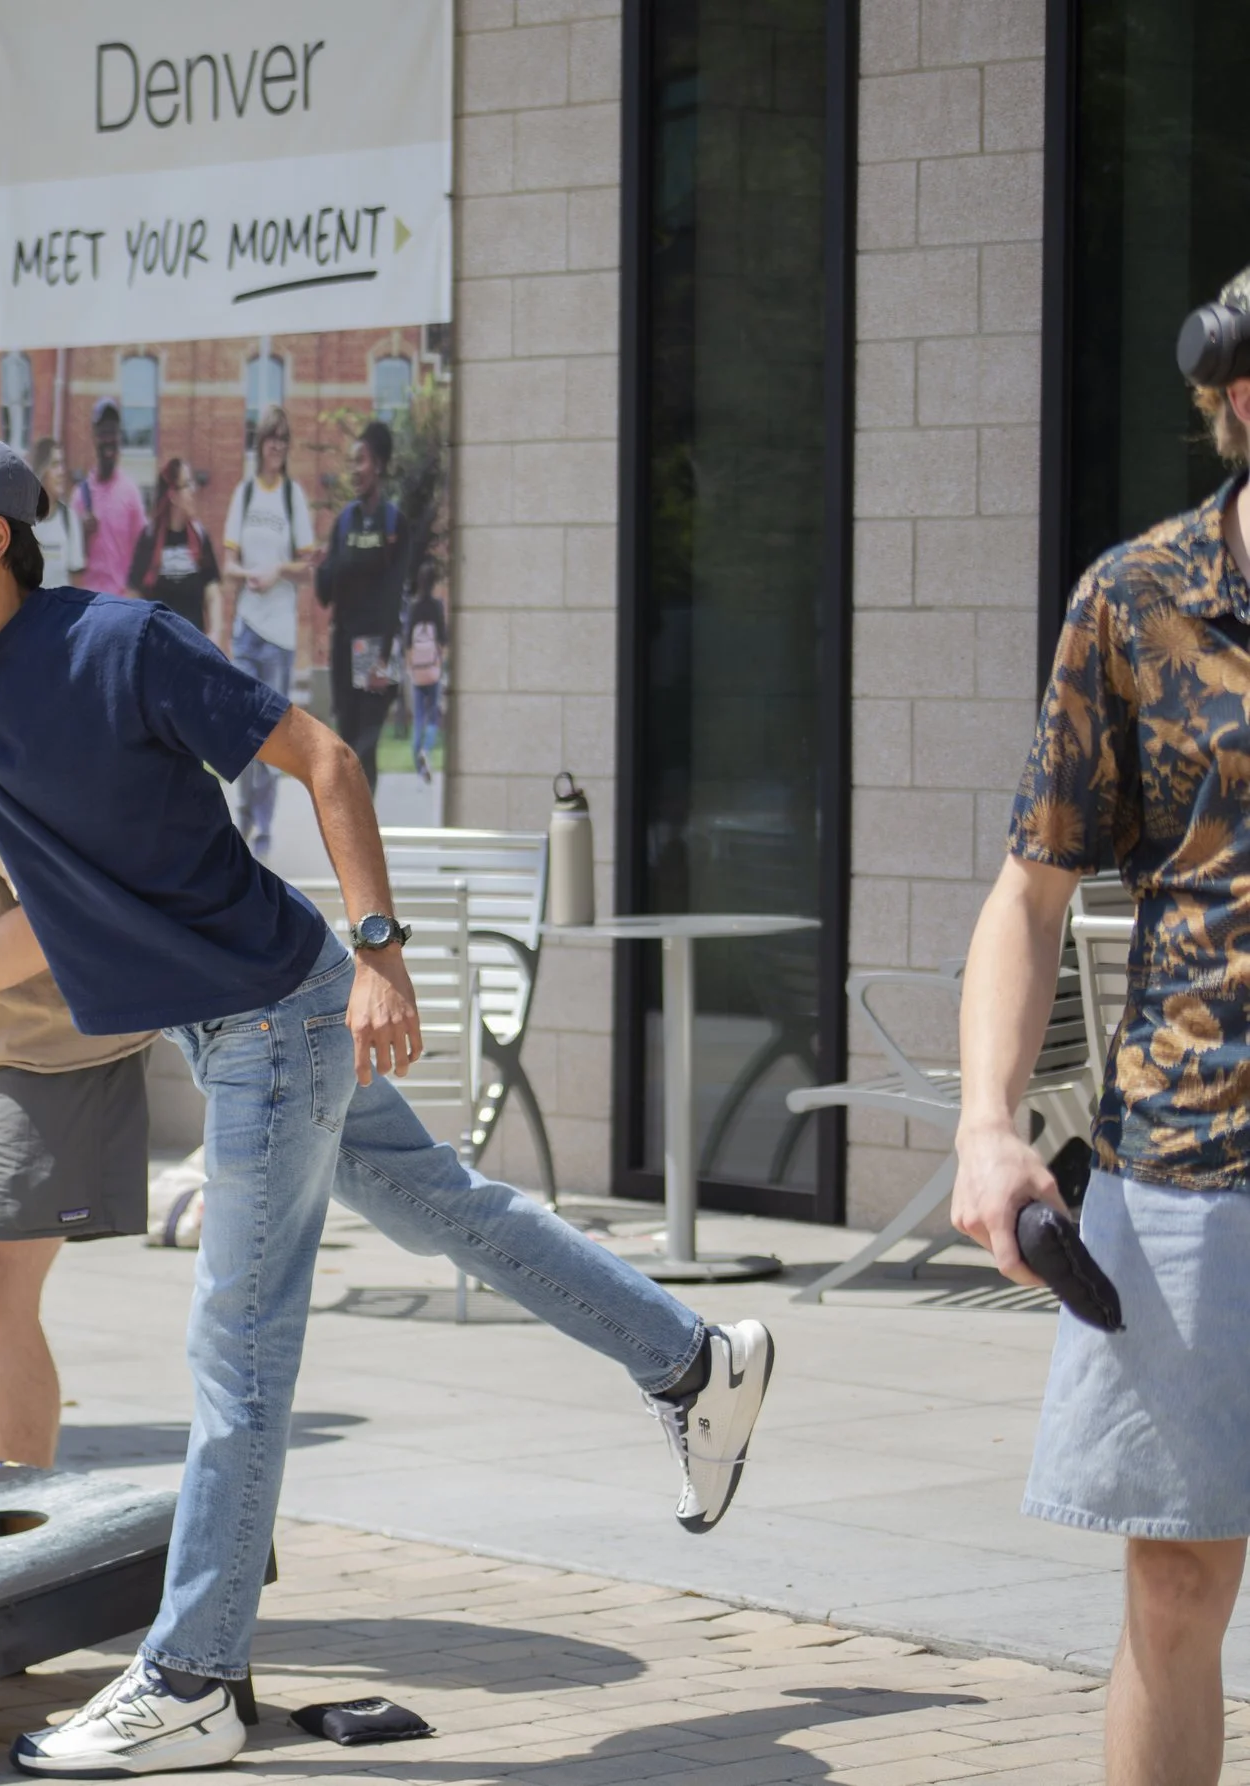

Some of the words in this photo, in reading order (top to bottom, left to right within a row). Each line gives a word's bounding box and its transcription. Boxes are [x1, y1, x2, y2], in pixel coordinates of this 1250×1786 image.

[95, 40, 326, 134] Denver
[12, 230, 106, 288] MEET
[126, 218, 209, 290] YOUR
[227, 206, 387, 271] MOMENT
